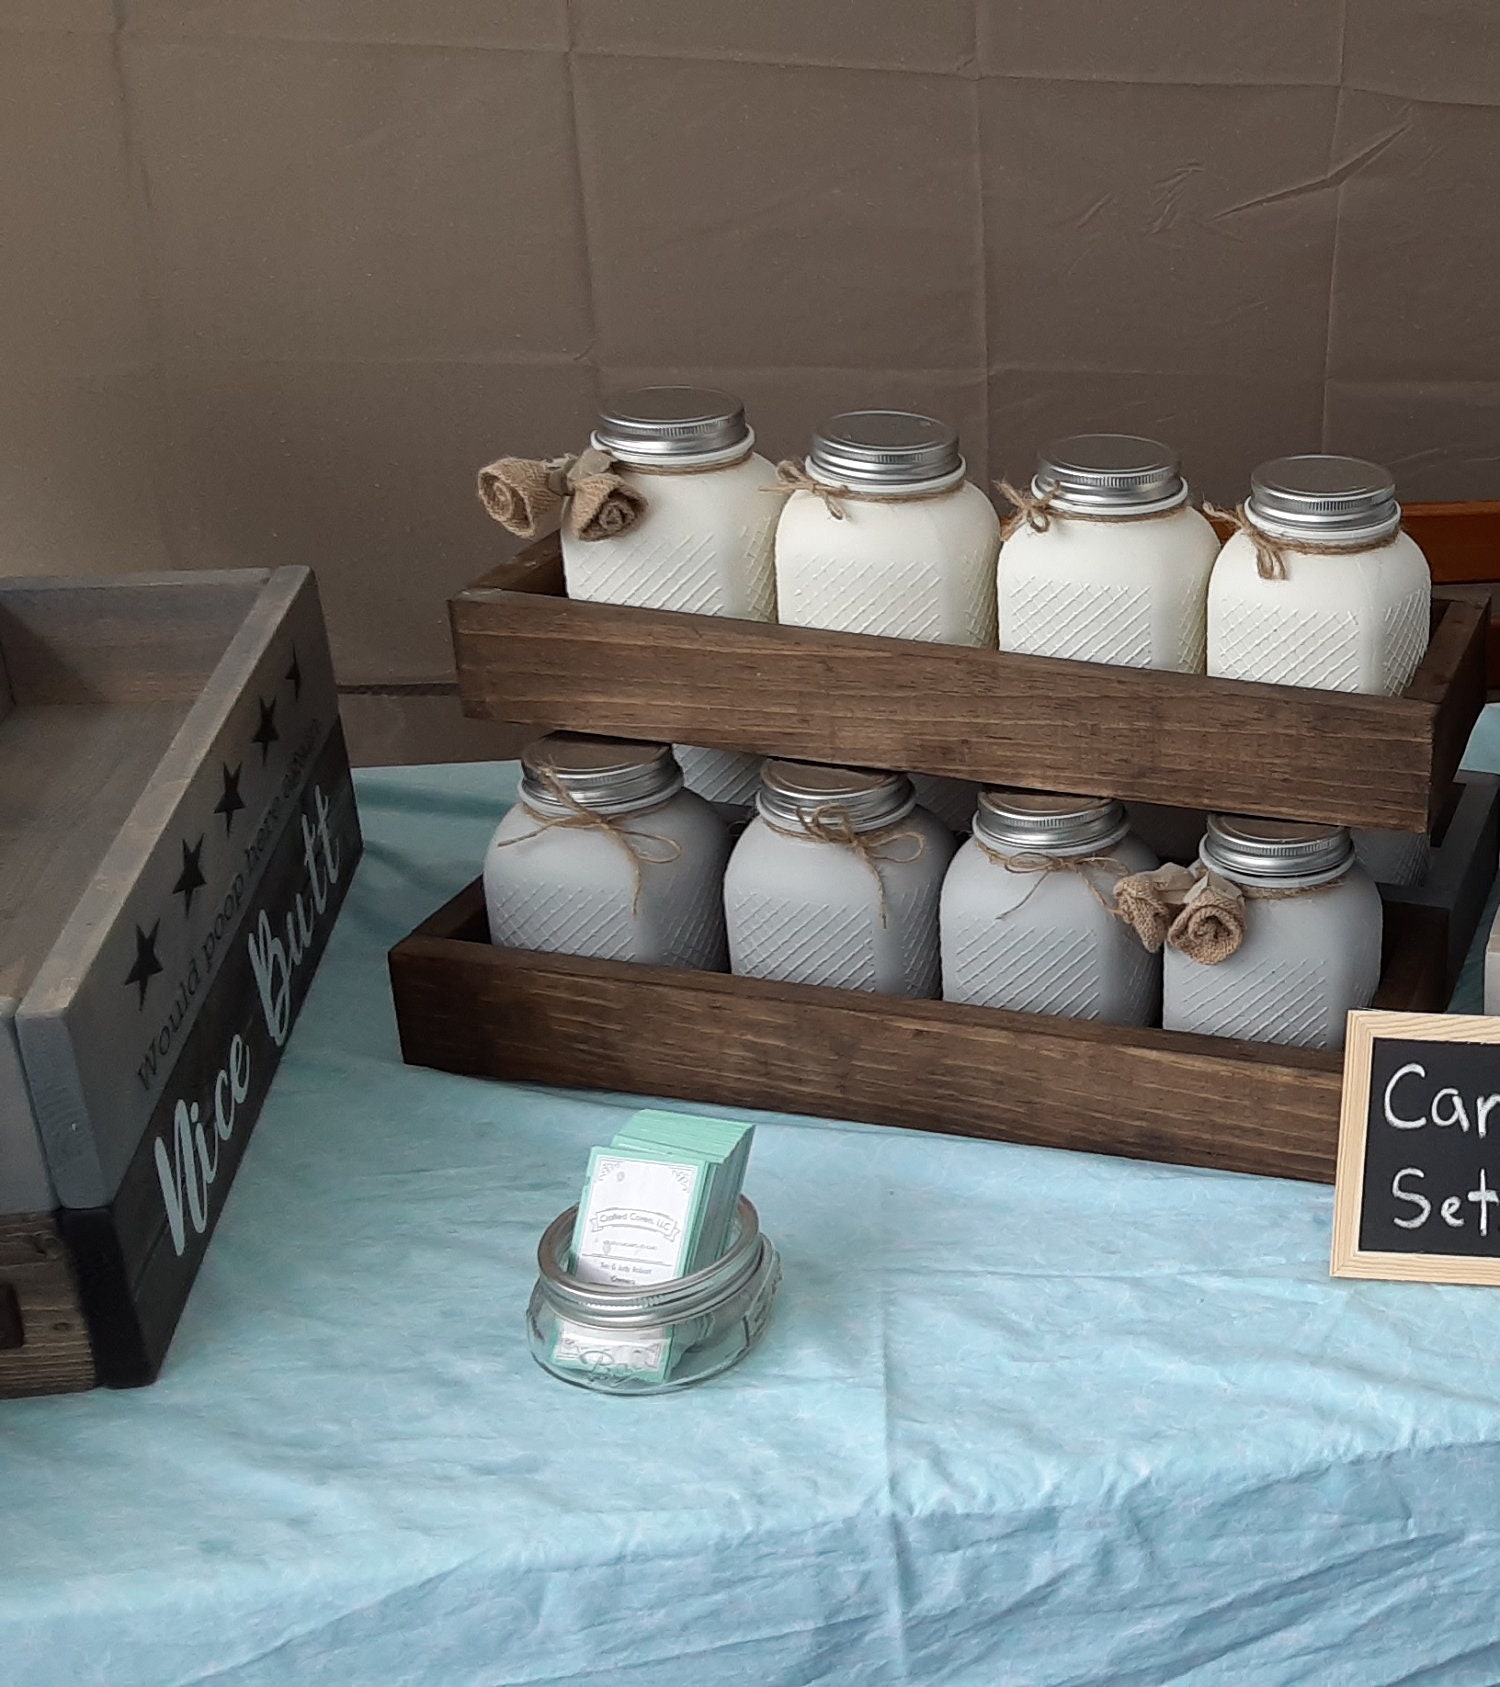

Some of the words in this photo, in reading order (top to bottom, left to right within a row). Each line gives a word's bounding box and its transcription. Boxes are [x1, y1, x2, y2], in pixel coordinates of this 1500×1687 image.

[137, 958, 200, 1090] Would
[203, 872, 245, 974] poop
[245, 796, 281, 870] here
[154, 1032, 252, 1258] Nice
[248, 785, 342, 1047] Butt
